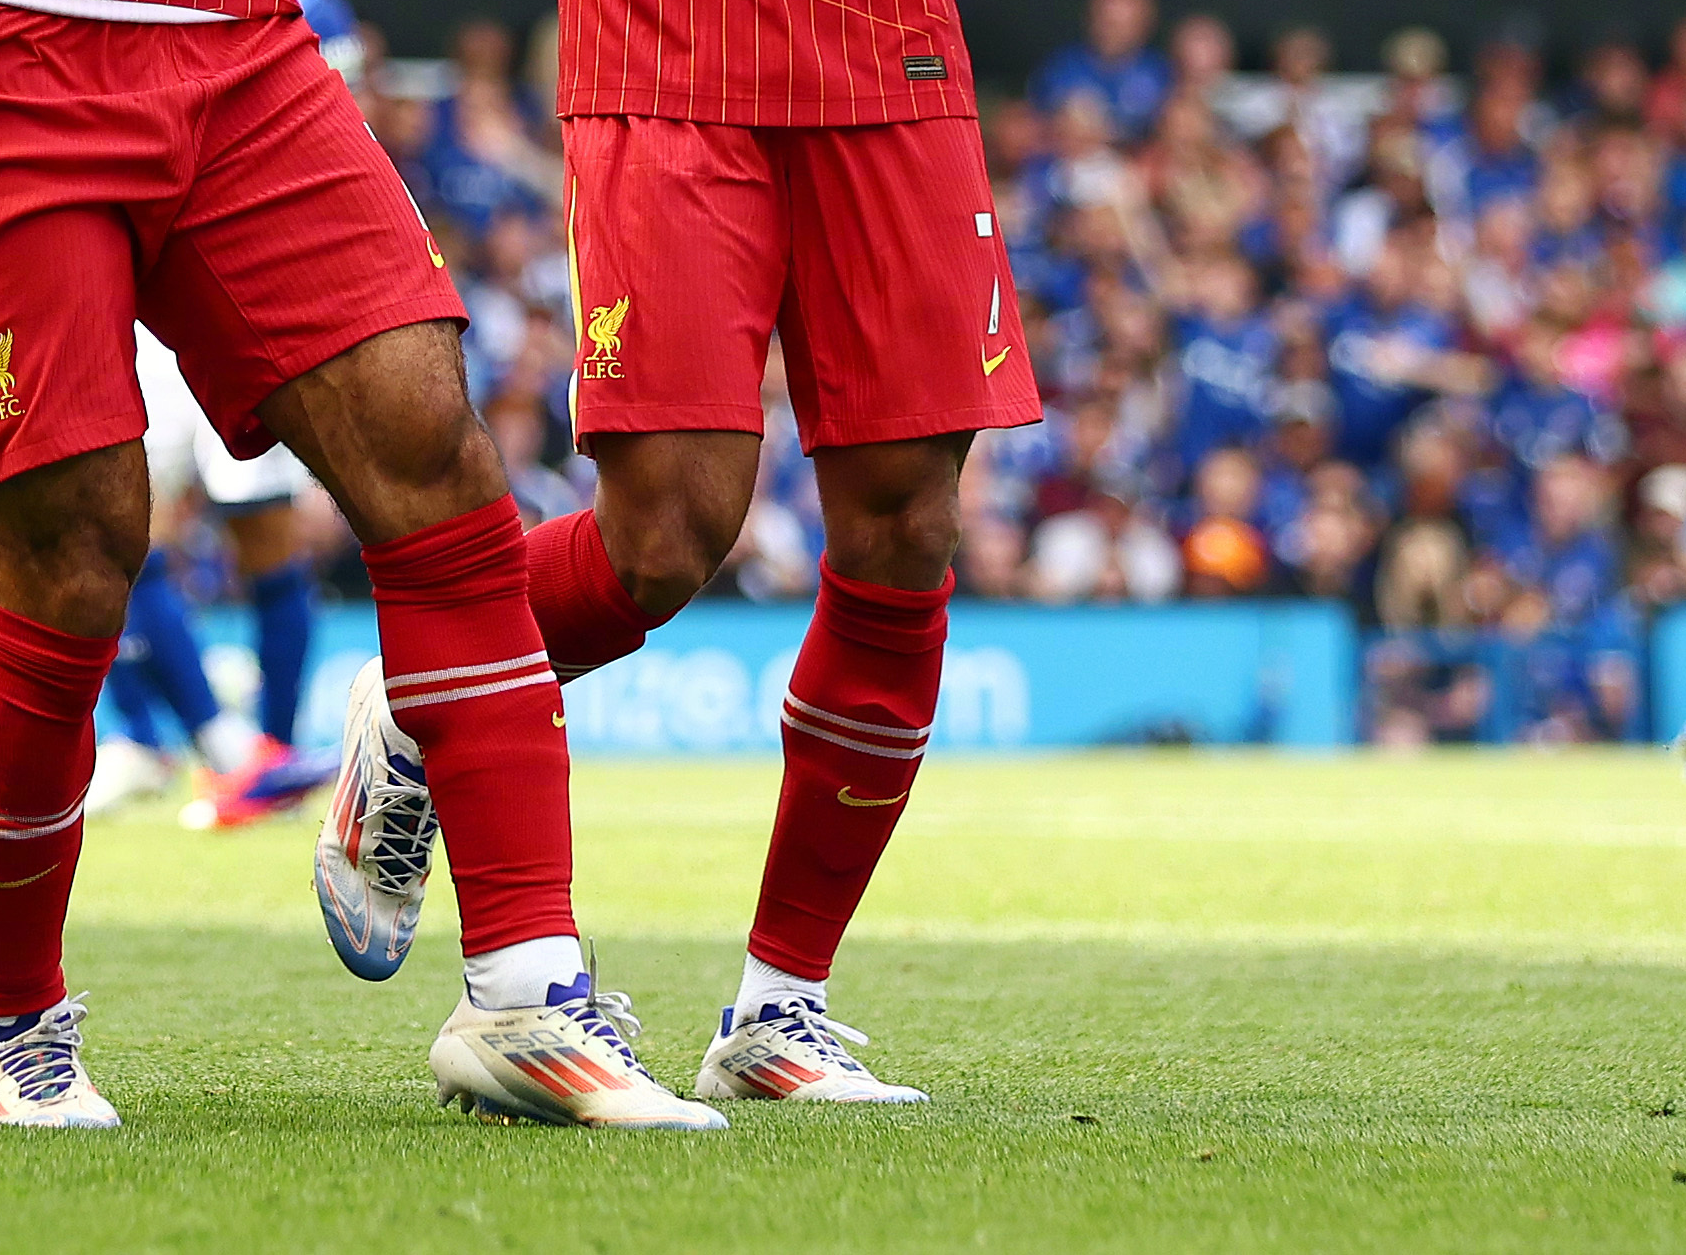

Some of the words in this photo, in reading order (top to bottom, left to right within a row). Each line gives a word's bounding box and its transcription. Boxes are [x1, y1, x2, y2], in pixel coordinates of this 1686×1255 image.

[582, 361, 625, 379] L.F.C.
[480, 1029, 565, 1051] F50
[719, 1044, 773, 1073] F50
